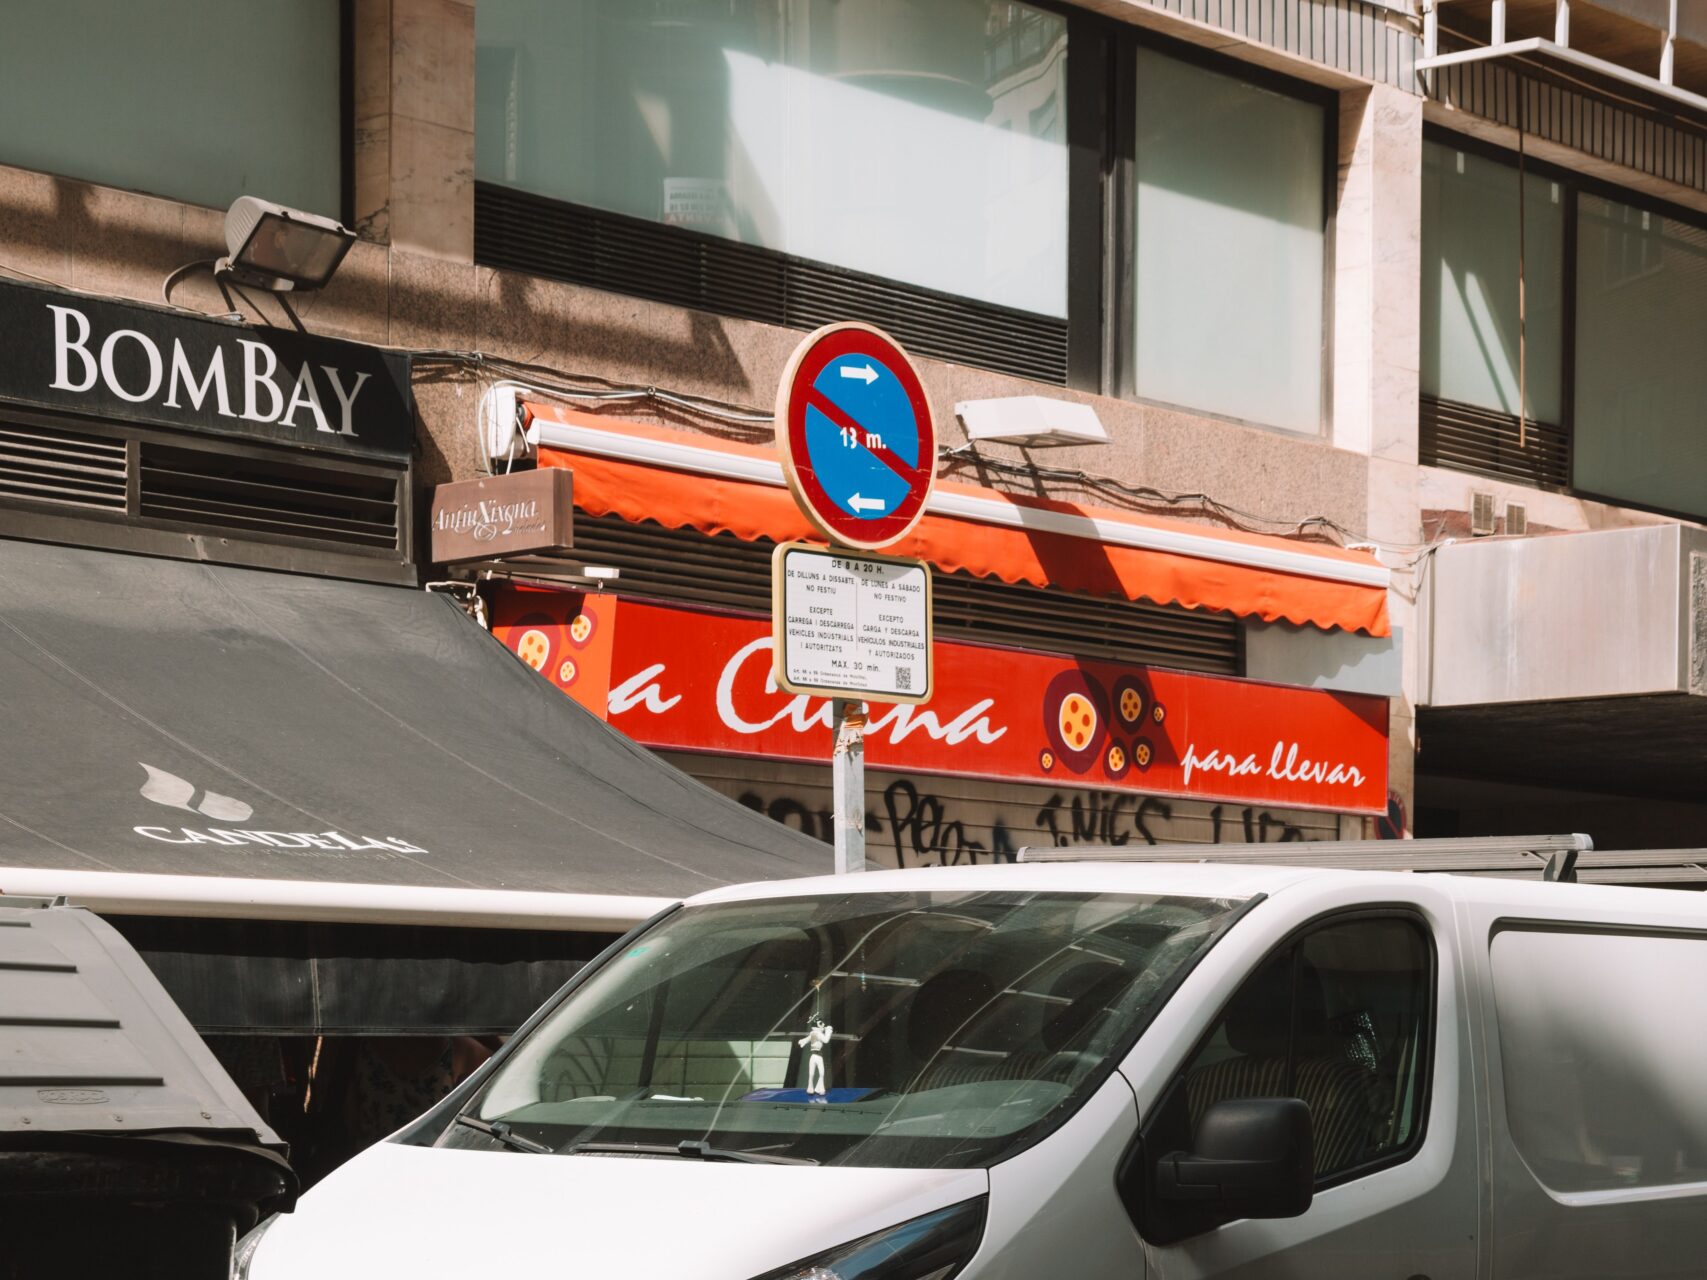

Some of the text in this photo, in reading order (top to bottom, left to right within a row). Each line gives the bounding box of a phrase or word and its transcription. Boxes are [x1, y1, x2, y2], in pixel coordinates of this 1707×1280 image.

[46, 304, 372, 437] BOMBAY
[840, 426, 887, 449] 13 m.
[832, 560, 841, 568] DE
[854, 562, 859, 571] A
[864, 564, 873, 572] 20
[877, 566, 884, 574] H.
[788, 569, 795, 577] DE
[797, 571, 820, 580] DILLUNS
[829, 575, 855, 585] DISSABTE
[817, 586, 836, 594] FESTIU
[861, 579, 870, 587] DE
[871, 580, 888, 589] LUNES
[885, 594, 907, 603] FESTIVO
[809, 606, 833, 615] EXCEPTE
[879, 614, 904, 624] EXCEPTO
[789, 629, 854, 642] VEHICLES INDUSTRIALS
[863, 625, 881, 633] CARGA
[891, 627, 920, 637] DESCARGA
[805, 643, 842, 653] AUTORITZATS
[888, 639, 925, 650] INDUSTRIALES
[875, 650, 915, 660] AUTORIZADOS
[831, 659, 881, 672] MAX. 30 min.
[1180, 740, 1366, 788] para llevar
[133, 826, 429, 854] CANDELAS
